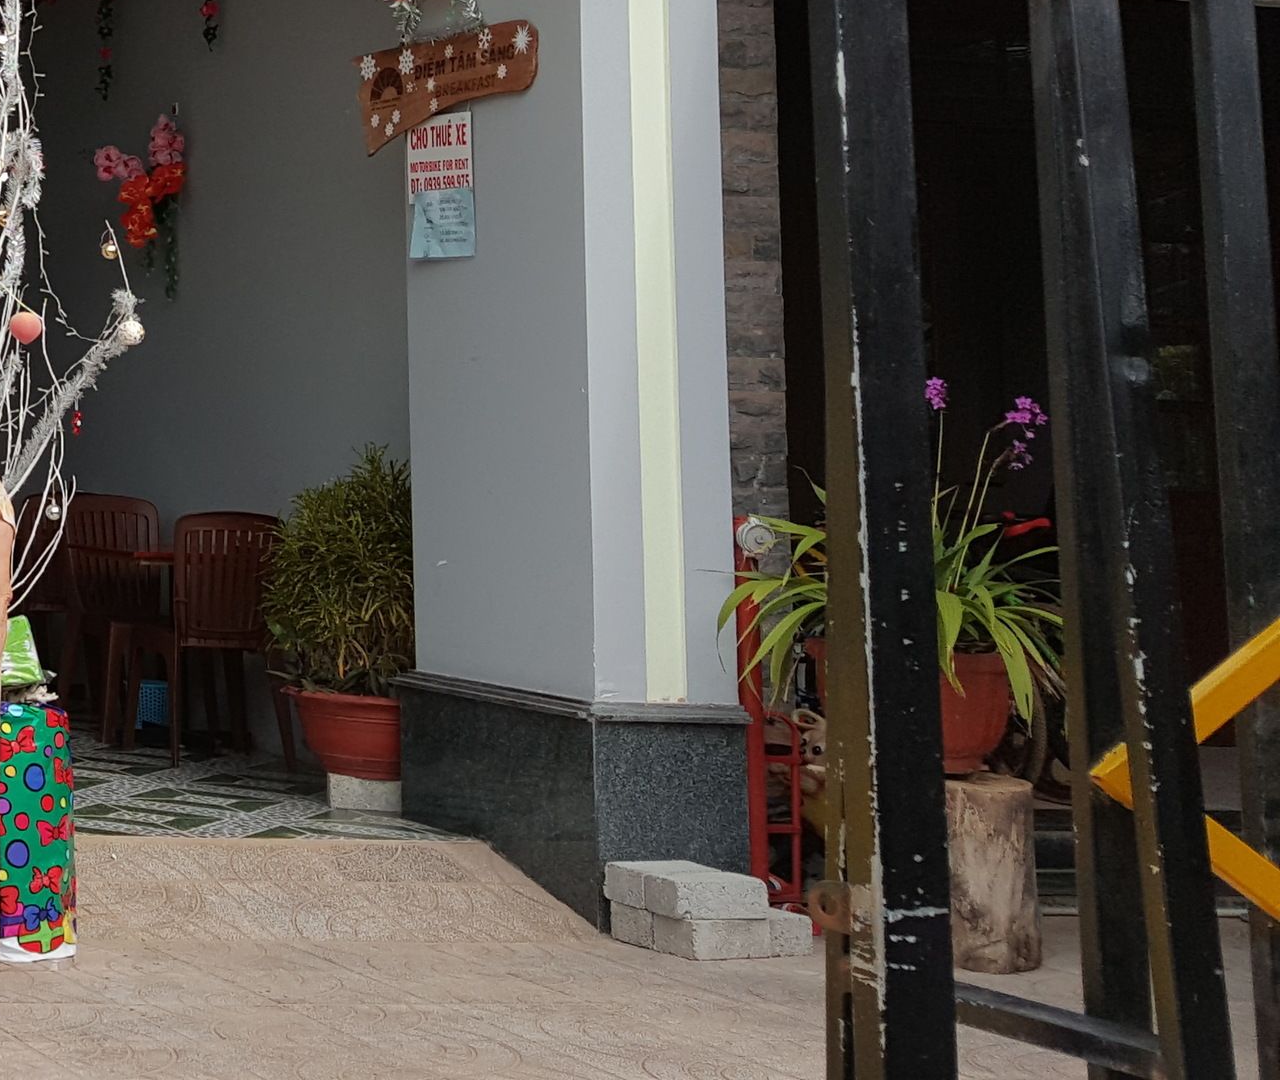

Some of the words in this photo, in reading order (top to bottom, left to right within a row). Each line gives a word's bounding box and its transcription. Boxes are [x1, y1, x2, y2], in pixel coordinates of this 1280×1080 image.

[435, 73, 497, 98] BREAKFAST
[410, 127, 428, 150] CHO
[430, 120, 452, 148] THUÊ
[455, 123, 467, 146] XE
[442, 159, 454, 171] FOR
[455, 158, 469, 170] RENT
